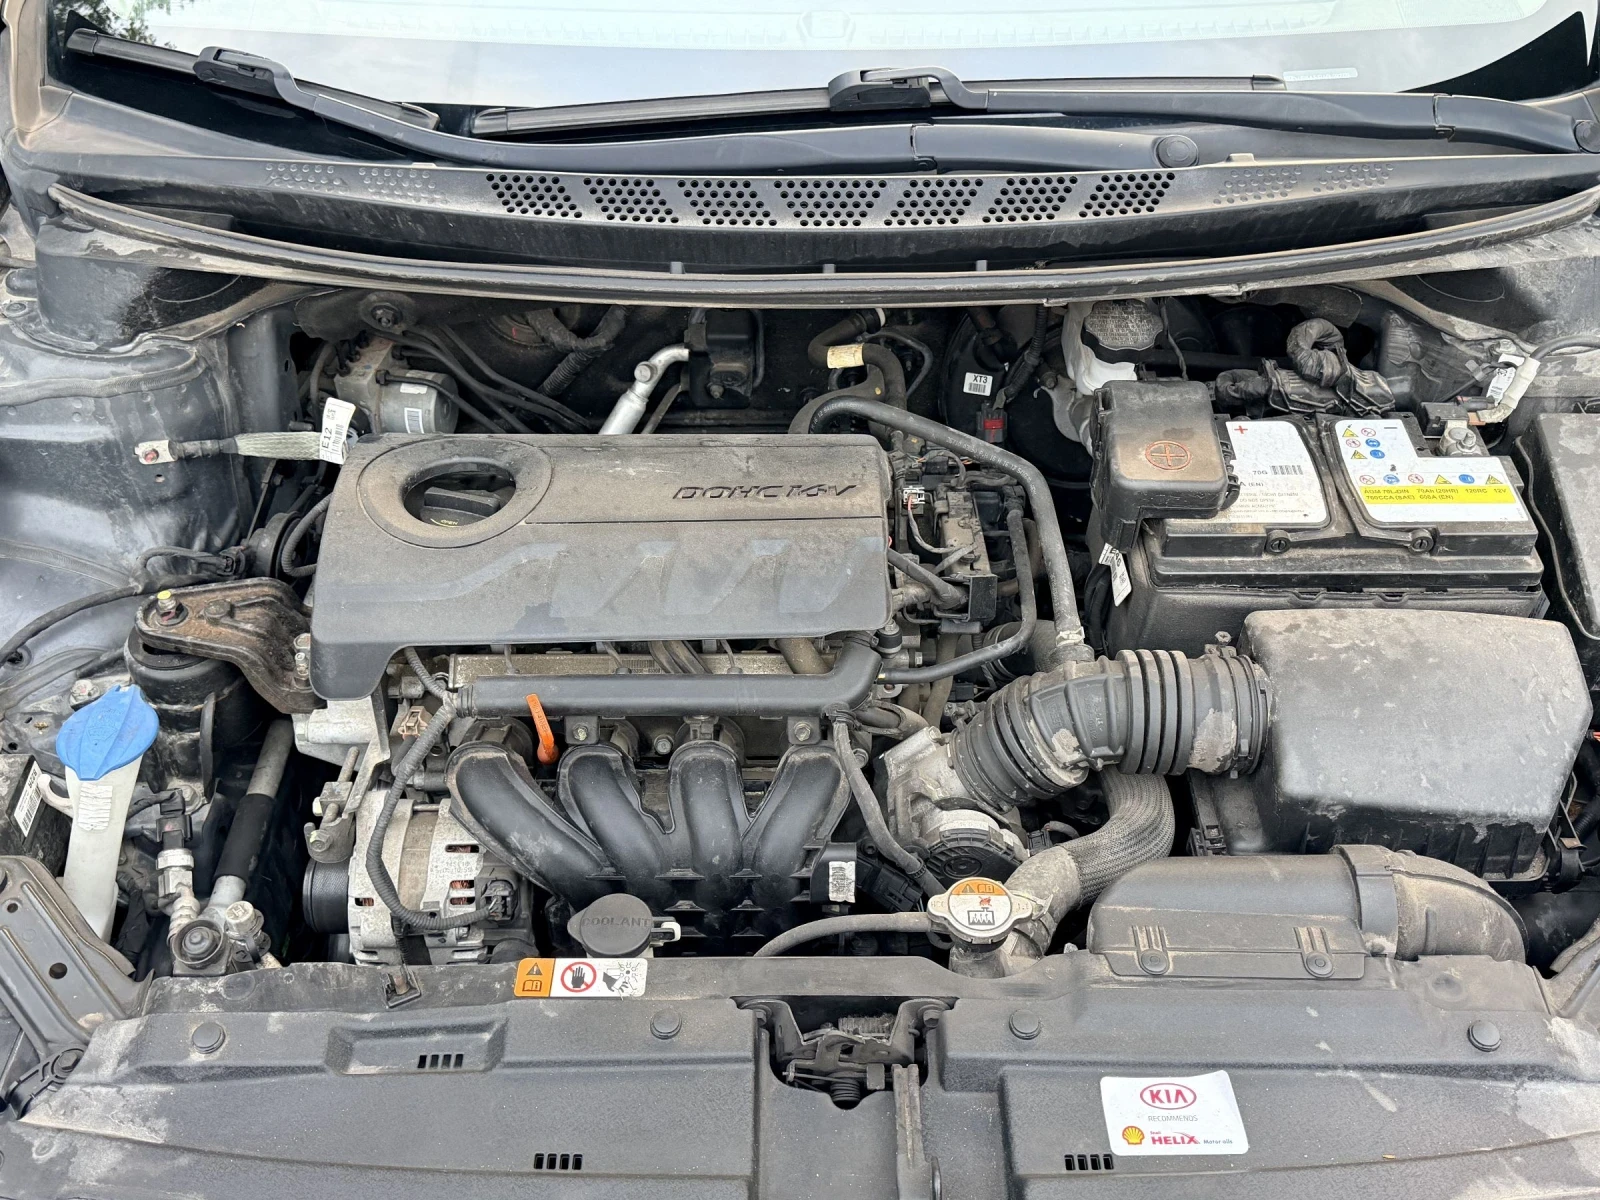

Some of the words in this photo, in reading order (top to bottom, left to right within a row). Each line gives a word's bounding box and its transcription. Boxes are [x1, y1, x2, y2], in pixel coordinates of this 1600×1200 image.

[973, 374, 988, 384] XT3
[322, 428, 333, 449] E12
[672, 485, 783, 499] DOHC
[581, 916, 652, 927] COOLANT
[1149, 1089, 1189, 1104] KIA
[1151, 1135, 1201, 1145] HELIX
